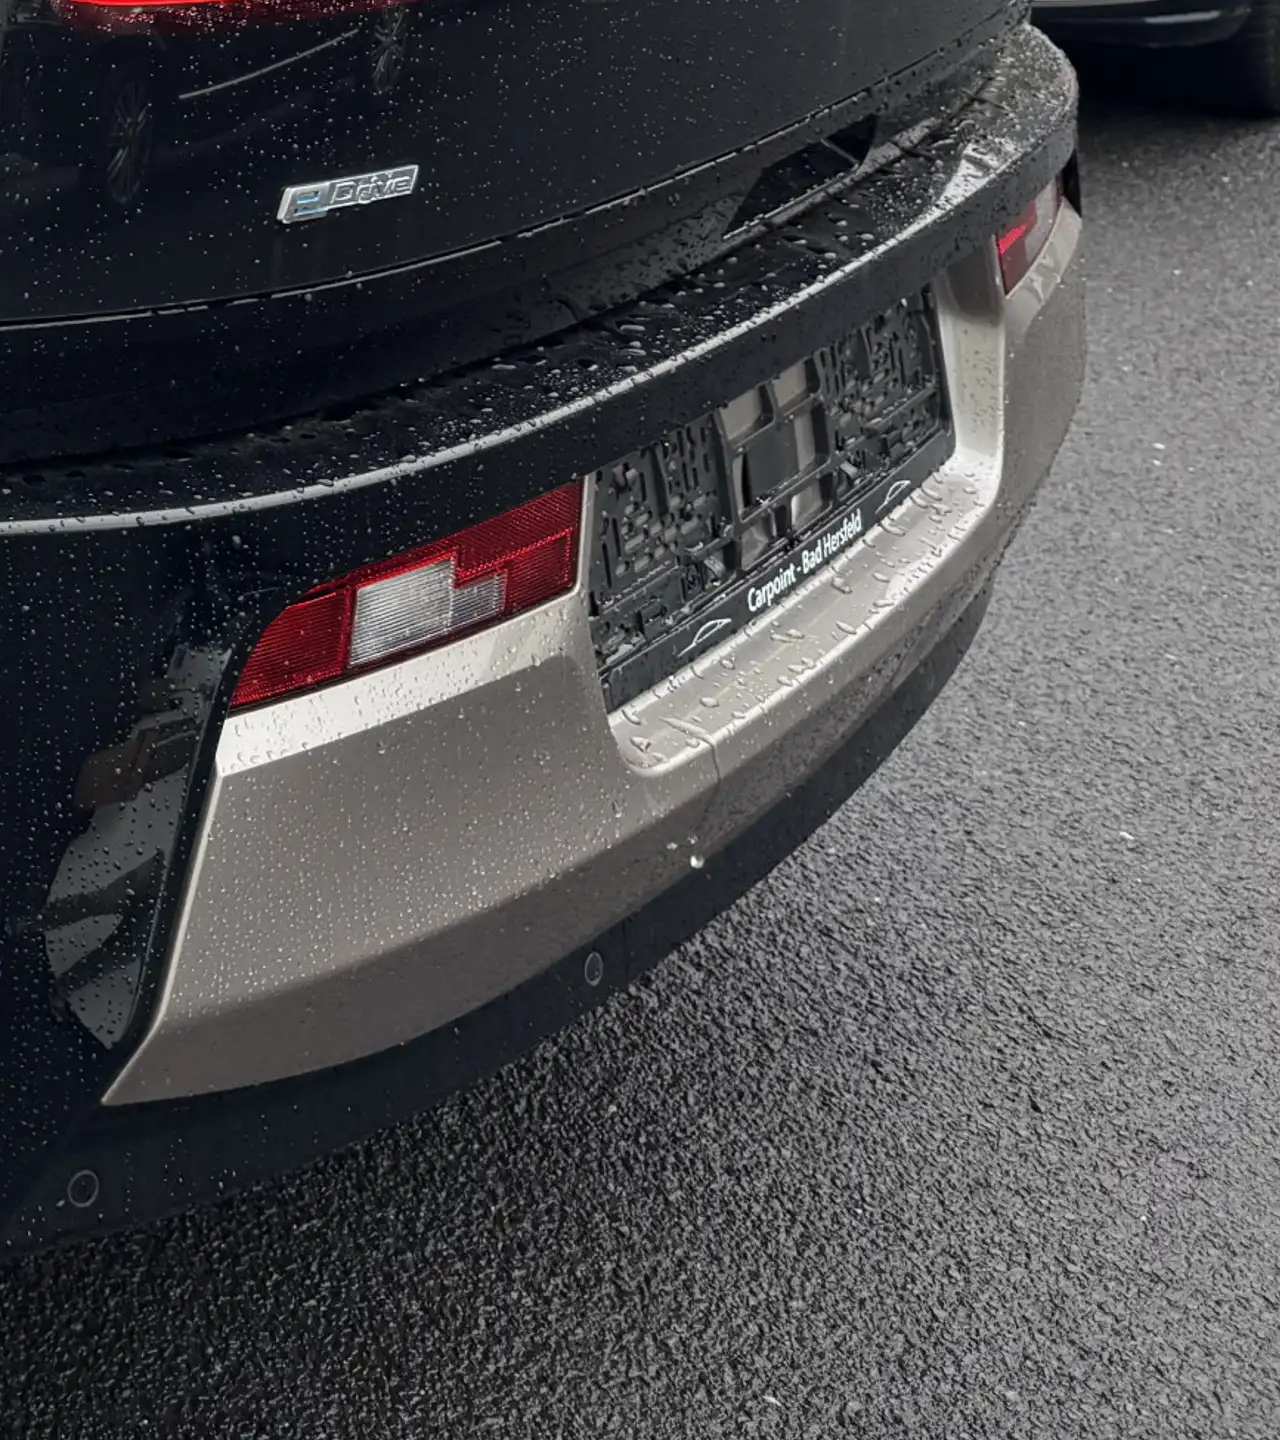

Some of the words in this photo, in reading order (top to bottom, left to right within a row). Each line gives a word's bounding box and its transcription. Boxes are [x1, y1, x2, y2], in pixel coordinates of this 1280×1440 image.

[746, 562, 797, 613] Carpoint
[801, 539, 823, 575] Bad
[822, 507, 862, 558] Hersfeld
